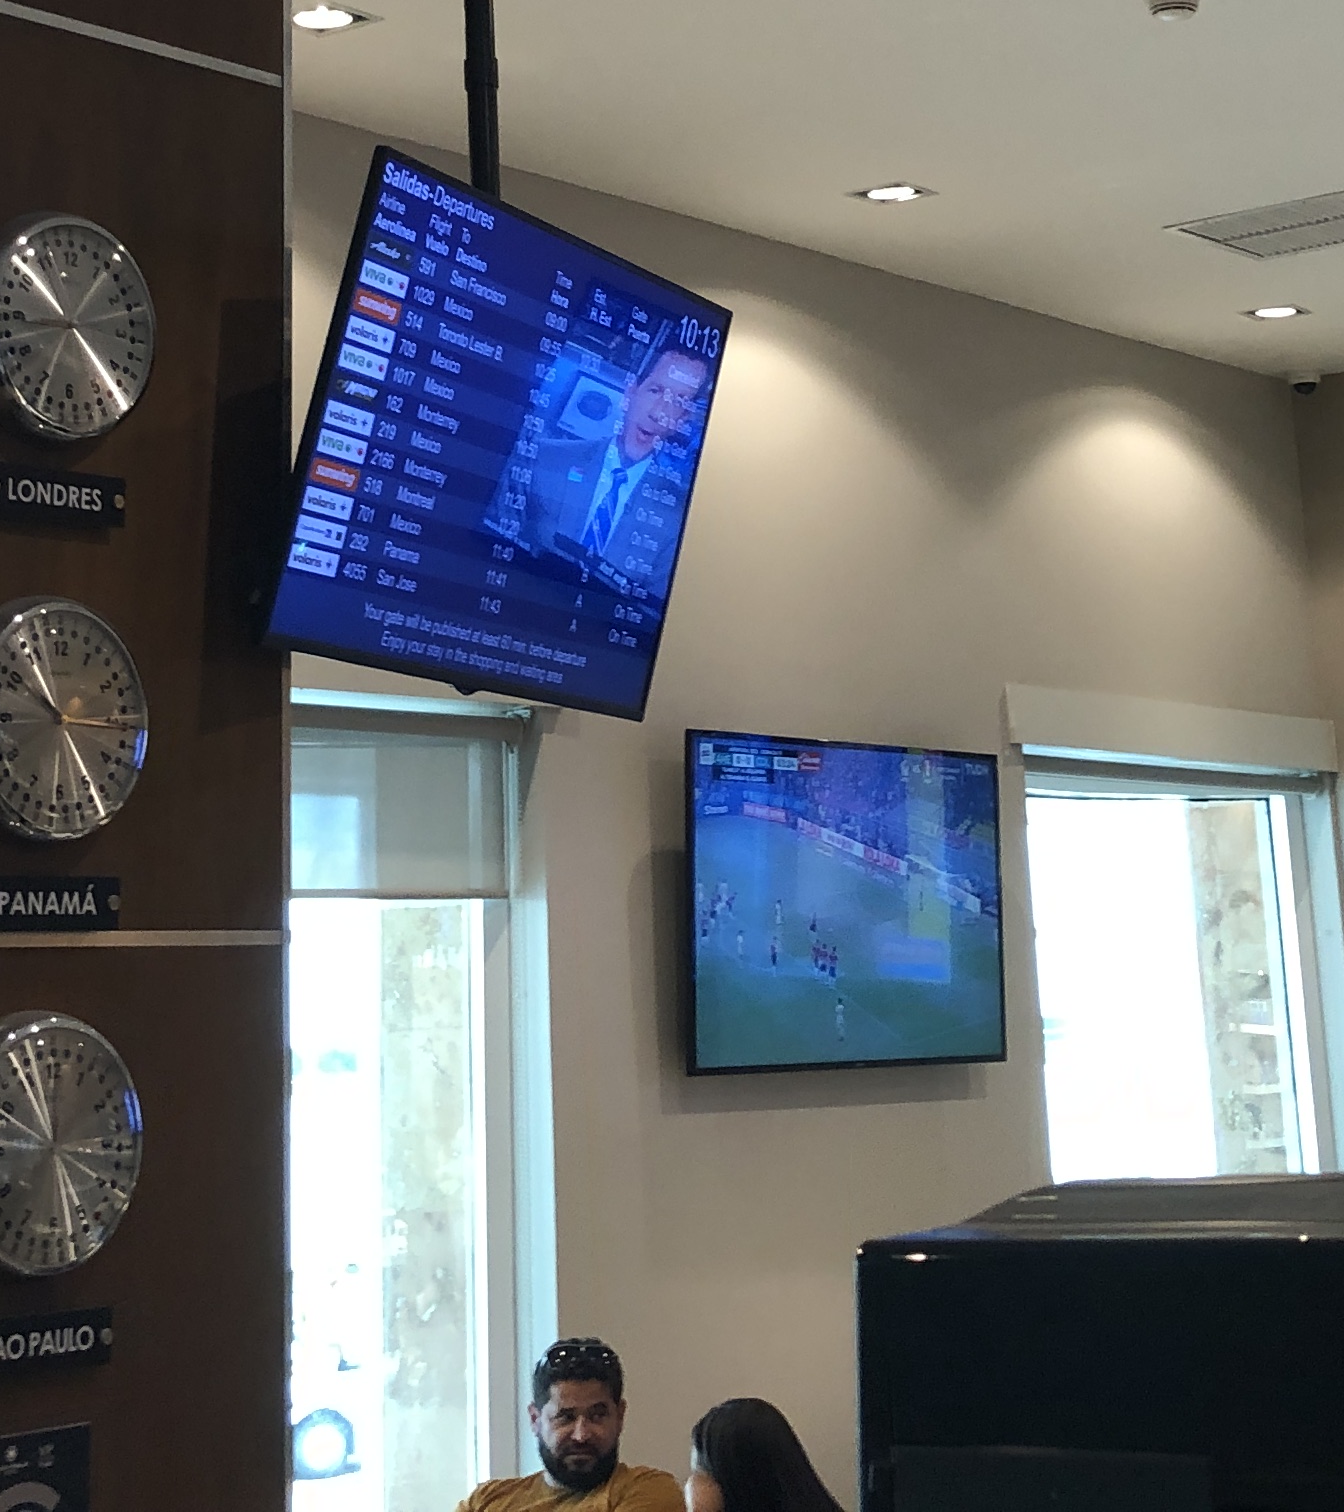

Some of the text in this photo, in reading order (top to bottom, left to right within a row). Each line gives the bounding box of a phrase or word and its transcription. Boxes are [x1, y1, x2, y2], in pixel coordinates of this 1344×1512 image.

[383, 162, 494, 230] Salidas-Departures
[462, 228, 471, 243] To
[678, 316, 719, 358] 10:13
[7, 477, 104, 512] LONDRES
[28, 1325, 95, 1357] PAULO
